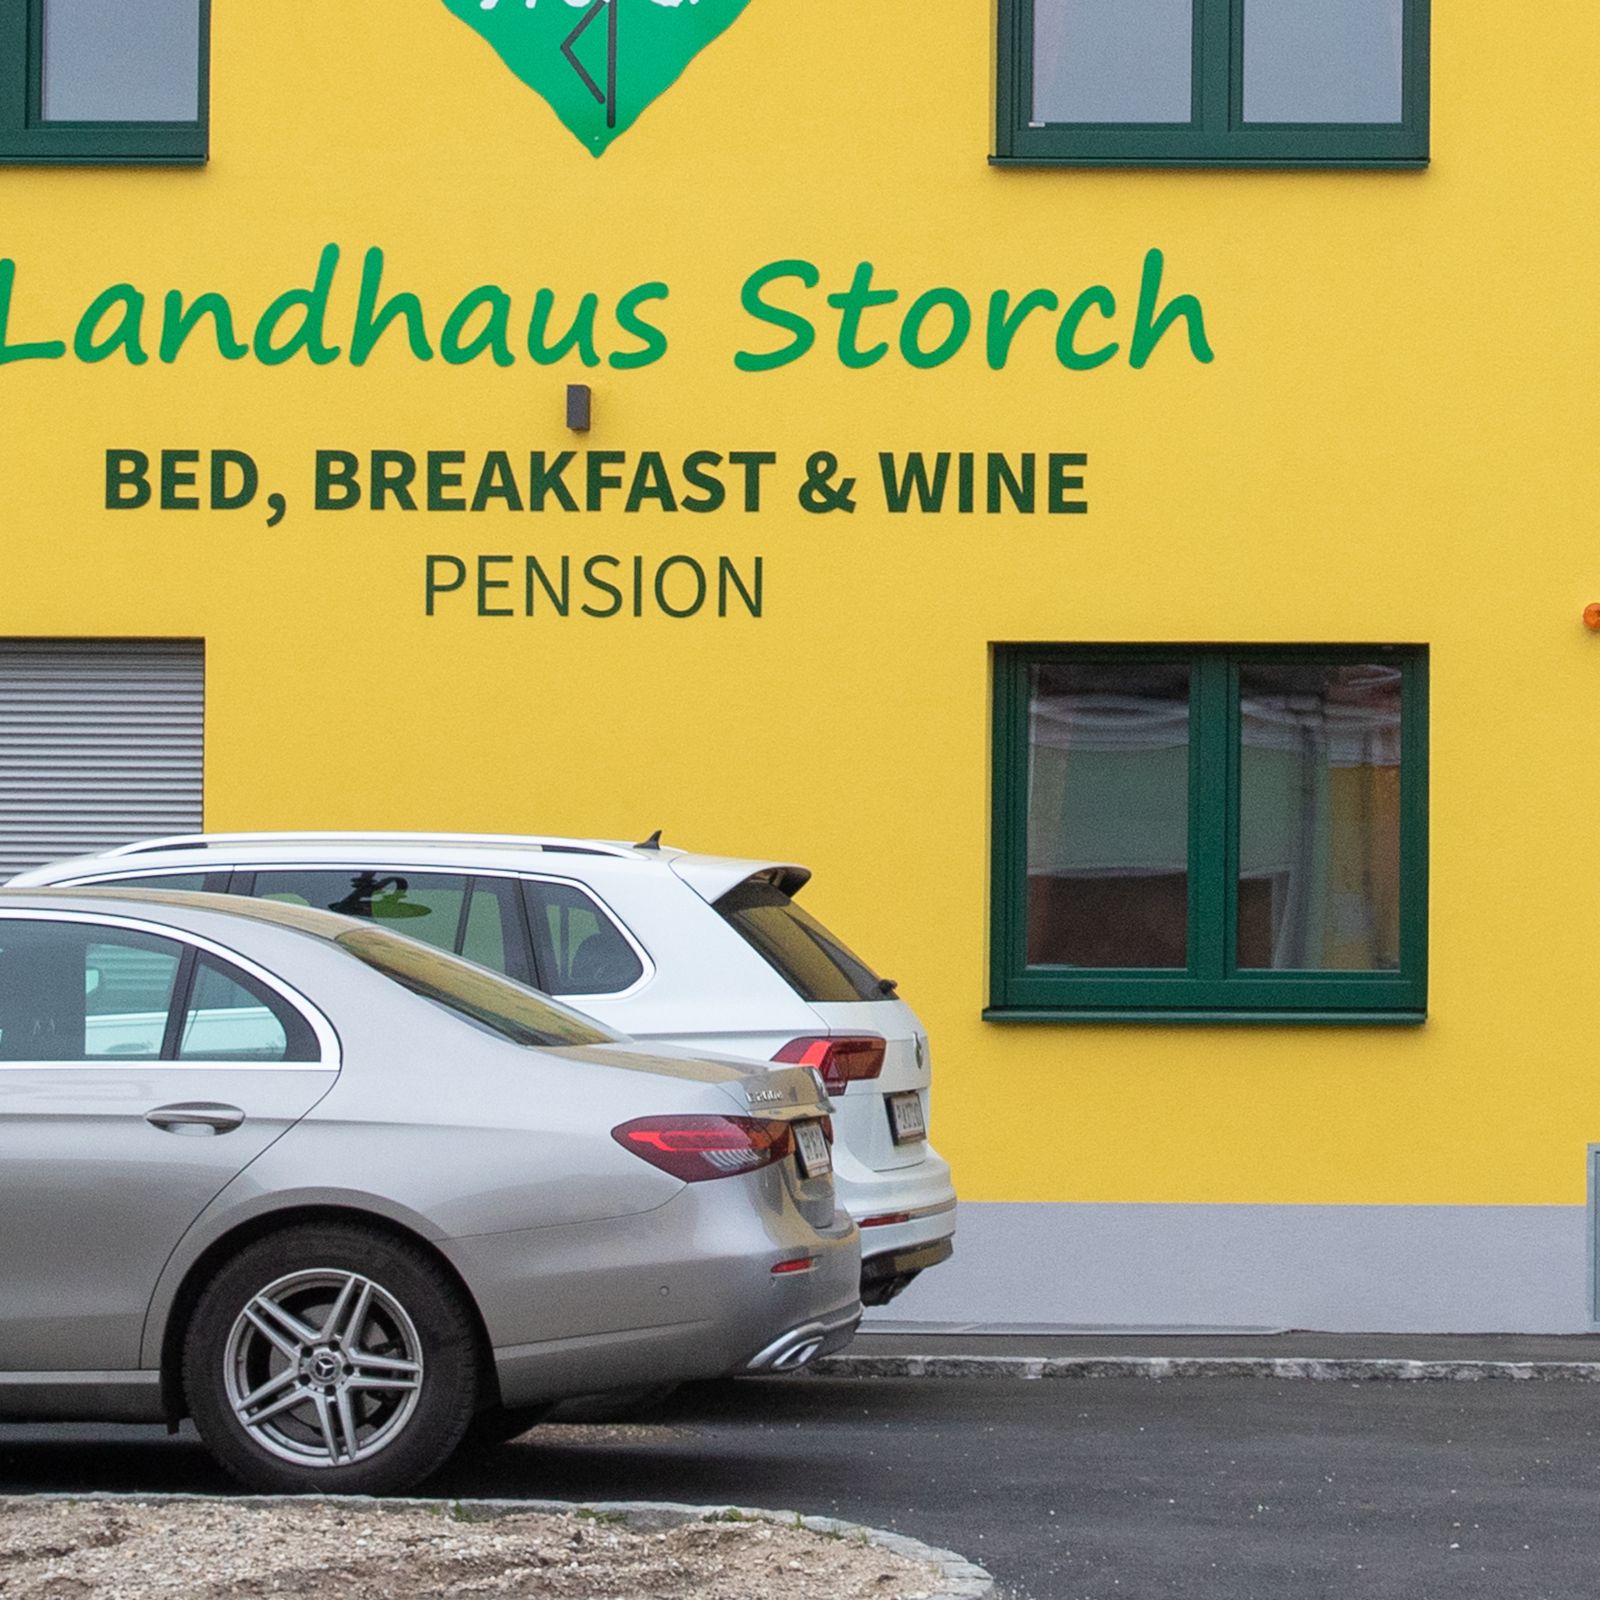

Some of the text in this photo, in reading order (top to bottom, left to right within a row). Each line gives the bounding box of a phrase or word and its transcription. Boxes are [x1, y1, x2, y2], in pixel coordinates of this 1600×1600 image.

[733, 247, 1215, 373] Storch
[105, 449, 1089, 528] BED, BREAKFAST & WINE
[425, 554, 764, 619] PENSION
